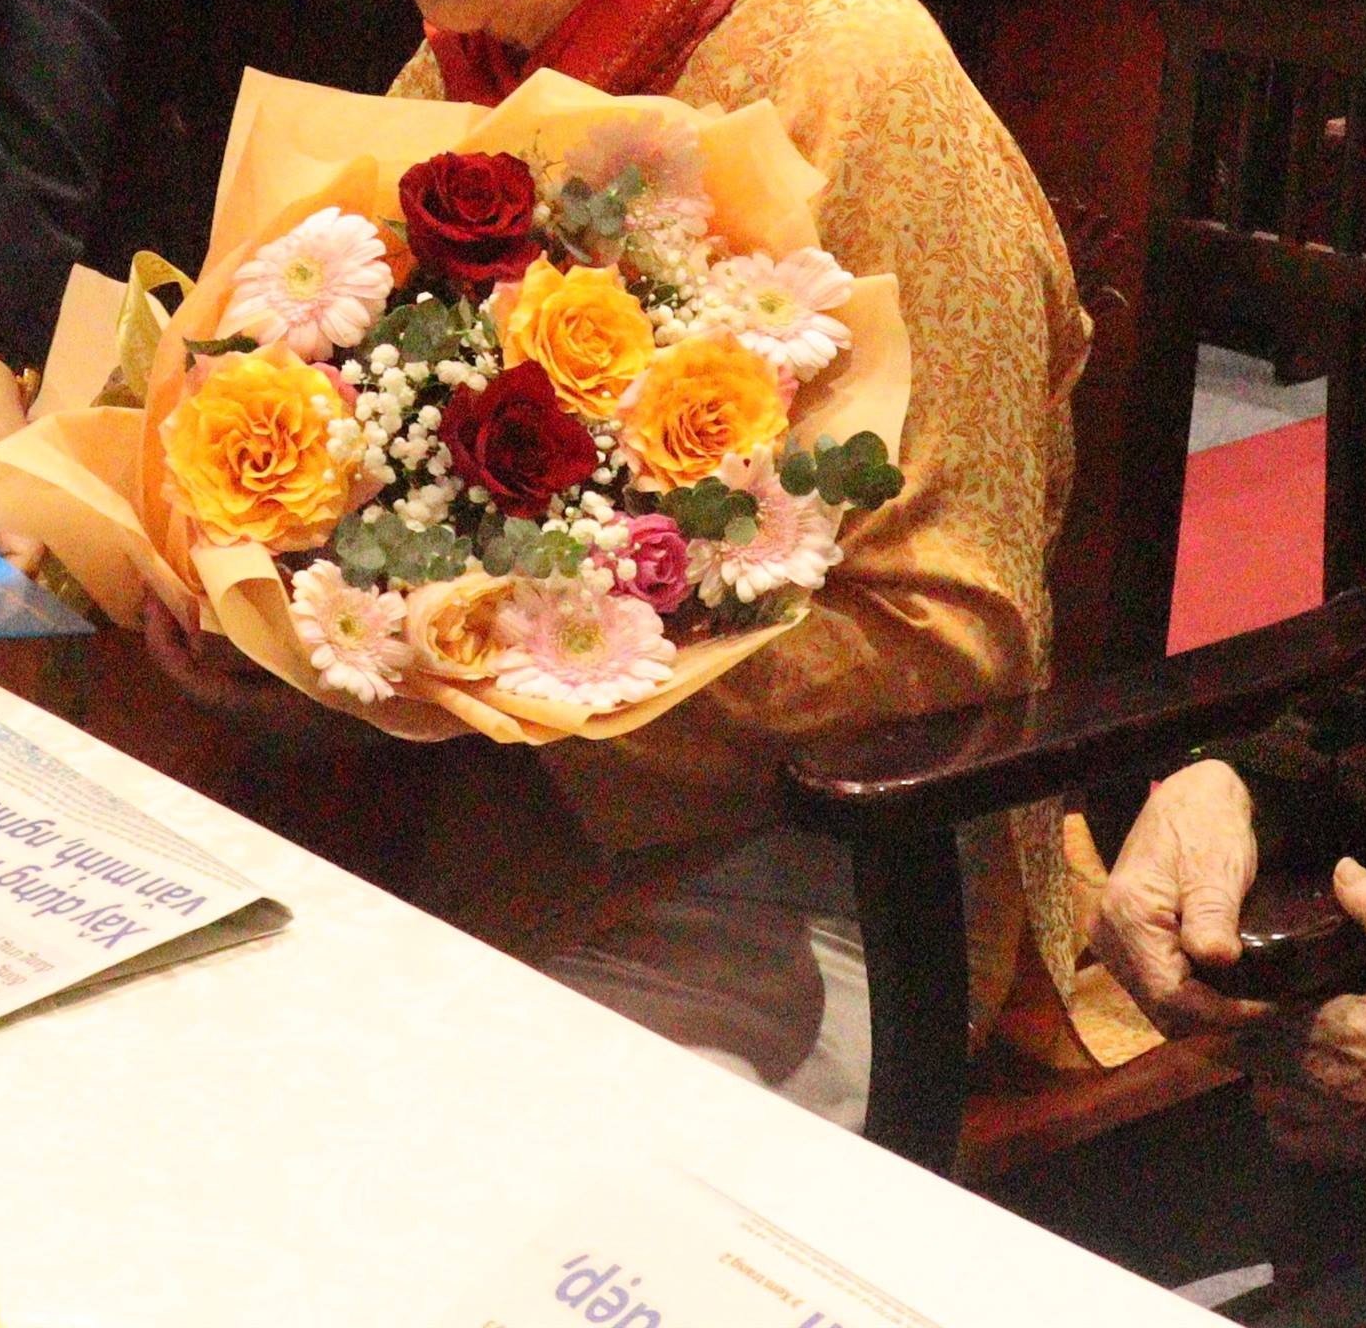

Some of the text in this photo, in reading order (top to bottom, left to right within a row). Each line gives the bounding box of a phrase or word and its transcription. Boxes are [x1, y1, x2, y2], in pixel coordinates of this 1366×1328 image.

[51, 840, 148, 886] minh,
[136, 878, 206, 915] văn
[71, 905, 147, 948] Xây
